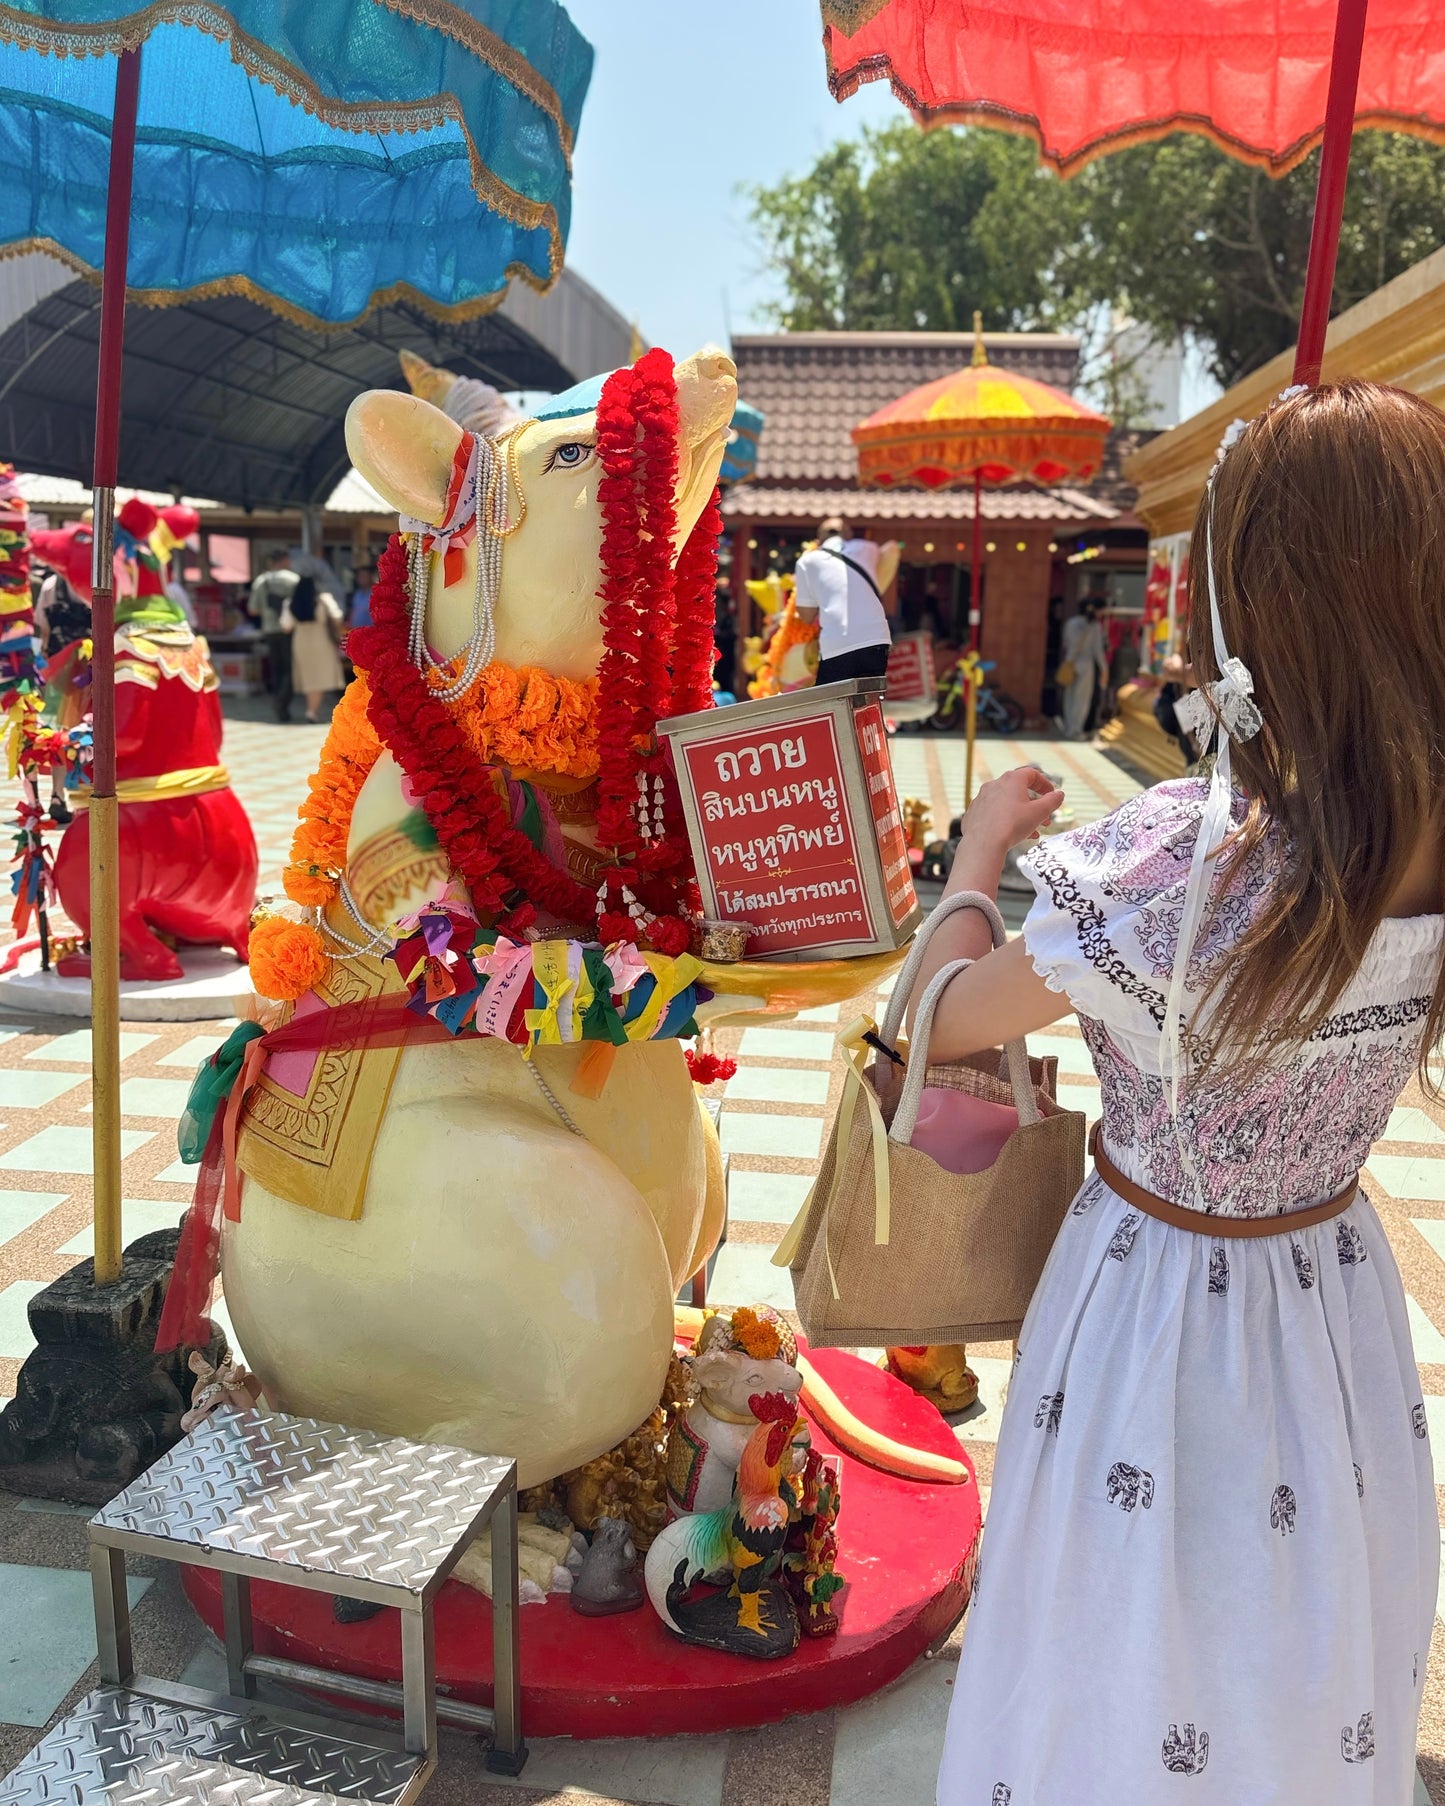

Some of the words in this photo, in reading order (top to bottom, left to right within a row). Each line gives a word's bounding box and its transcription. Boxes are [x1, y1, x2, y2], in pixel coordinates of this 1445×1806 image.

[714, 735, 807, 783] ถวาย
[701, 776, 839, 821] สินบนหนู
[711, 810, 845, 872] หนูหูทิพย์
[718, 877, 857, 914] ได้สมปรารถนา
